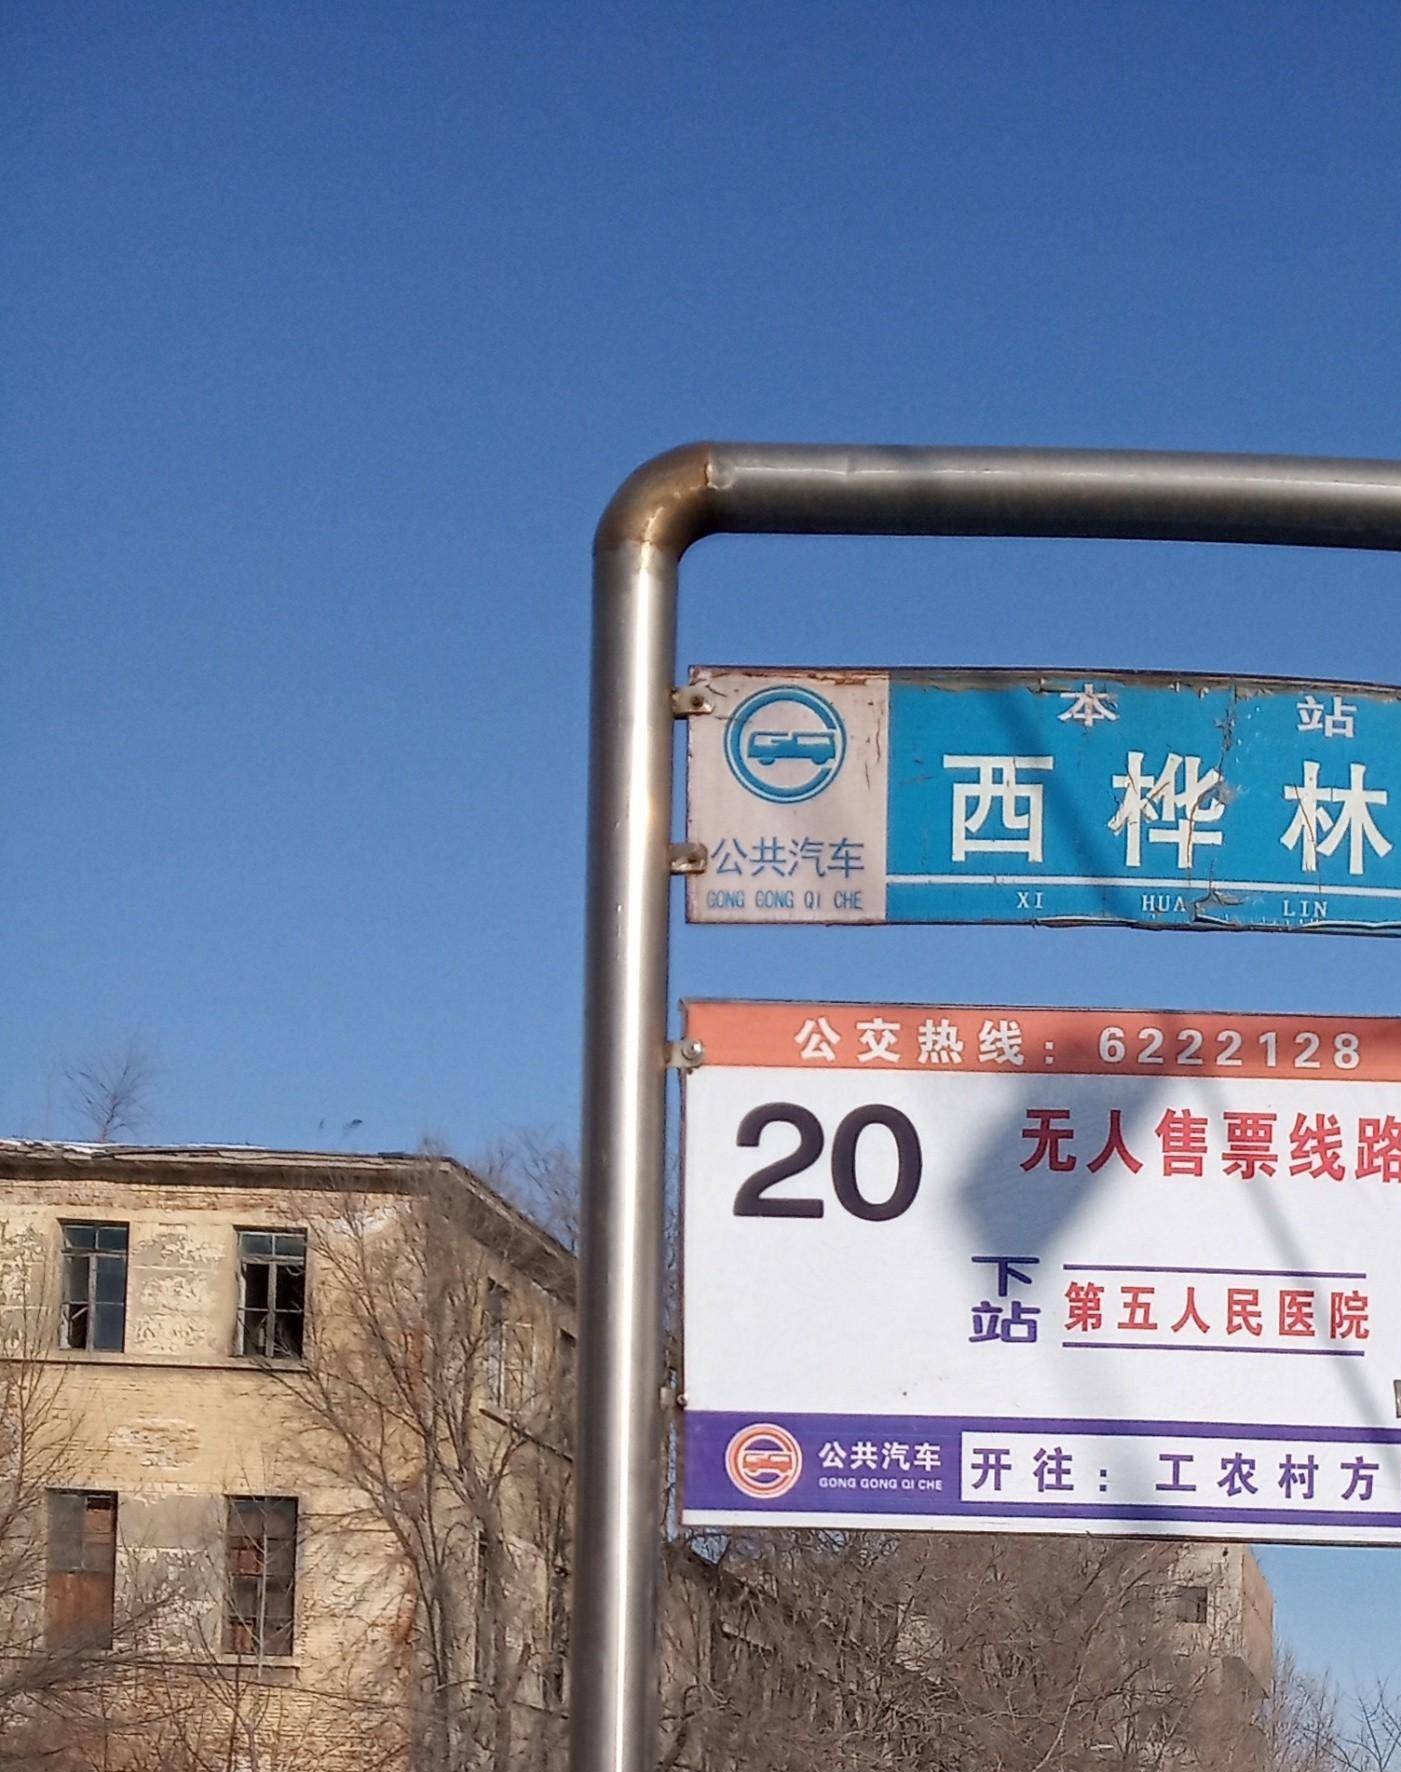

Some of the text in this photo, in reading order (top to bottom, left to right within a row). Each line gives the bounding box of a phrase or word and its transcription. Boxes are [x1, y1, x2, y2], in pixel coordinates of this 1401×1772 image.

[1058, 683, 1358, 738] 本站
[943, 750, 1393, 876] 西桦林
[710, 836, 865, 879] 公共汽车
[706, 889, 864, 911] GONG GONG QI CHE
[1016, 891, 1328, 918] XI HUA LIN
[732, 1101, 923, 1223] 20
[969, 1256, 1041, 1343] 下站
[1063, 1280, 1371, 1340] 第五人民医院
[818, 1440, 941, 1473] 公共汽车
[818, 1476, 943, 1492] GONG GONG QI CHE
